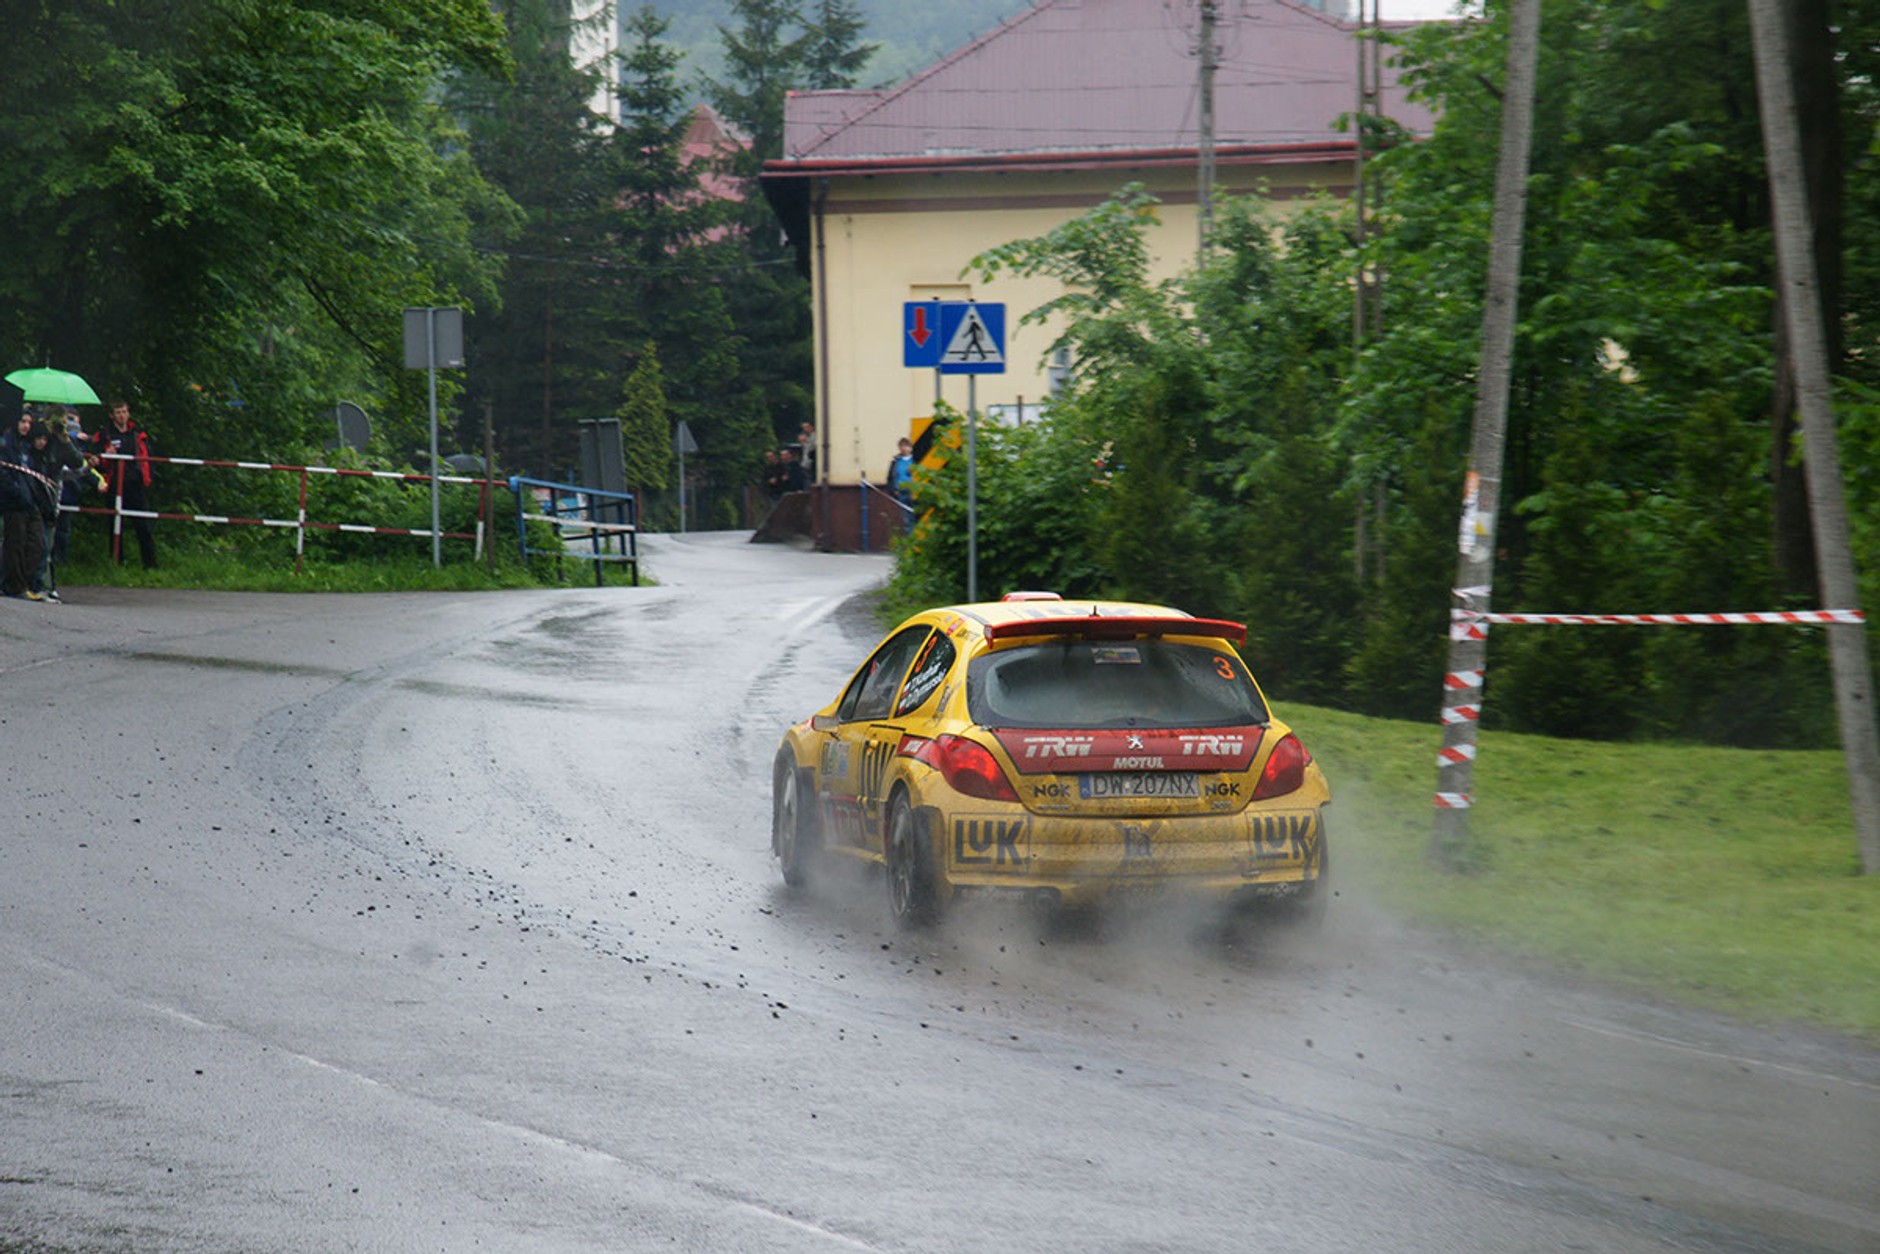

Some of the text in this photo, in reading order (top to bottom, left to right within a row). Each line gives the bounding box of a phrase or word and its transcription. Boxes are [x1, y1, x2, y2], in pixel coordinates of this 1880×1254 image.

[1213, 656, 1236, 680] 3
[1023, 736, 1095, 758] TRW
[1178, 735, 1244, 756] TRW
[1112, 757, 1165, 769] MOTUL
[1033, 783, 1072, 798] NGK
[1132, 774, 1196, 796] 207NX
[1204, 782, 1241, 797] NGK
